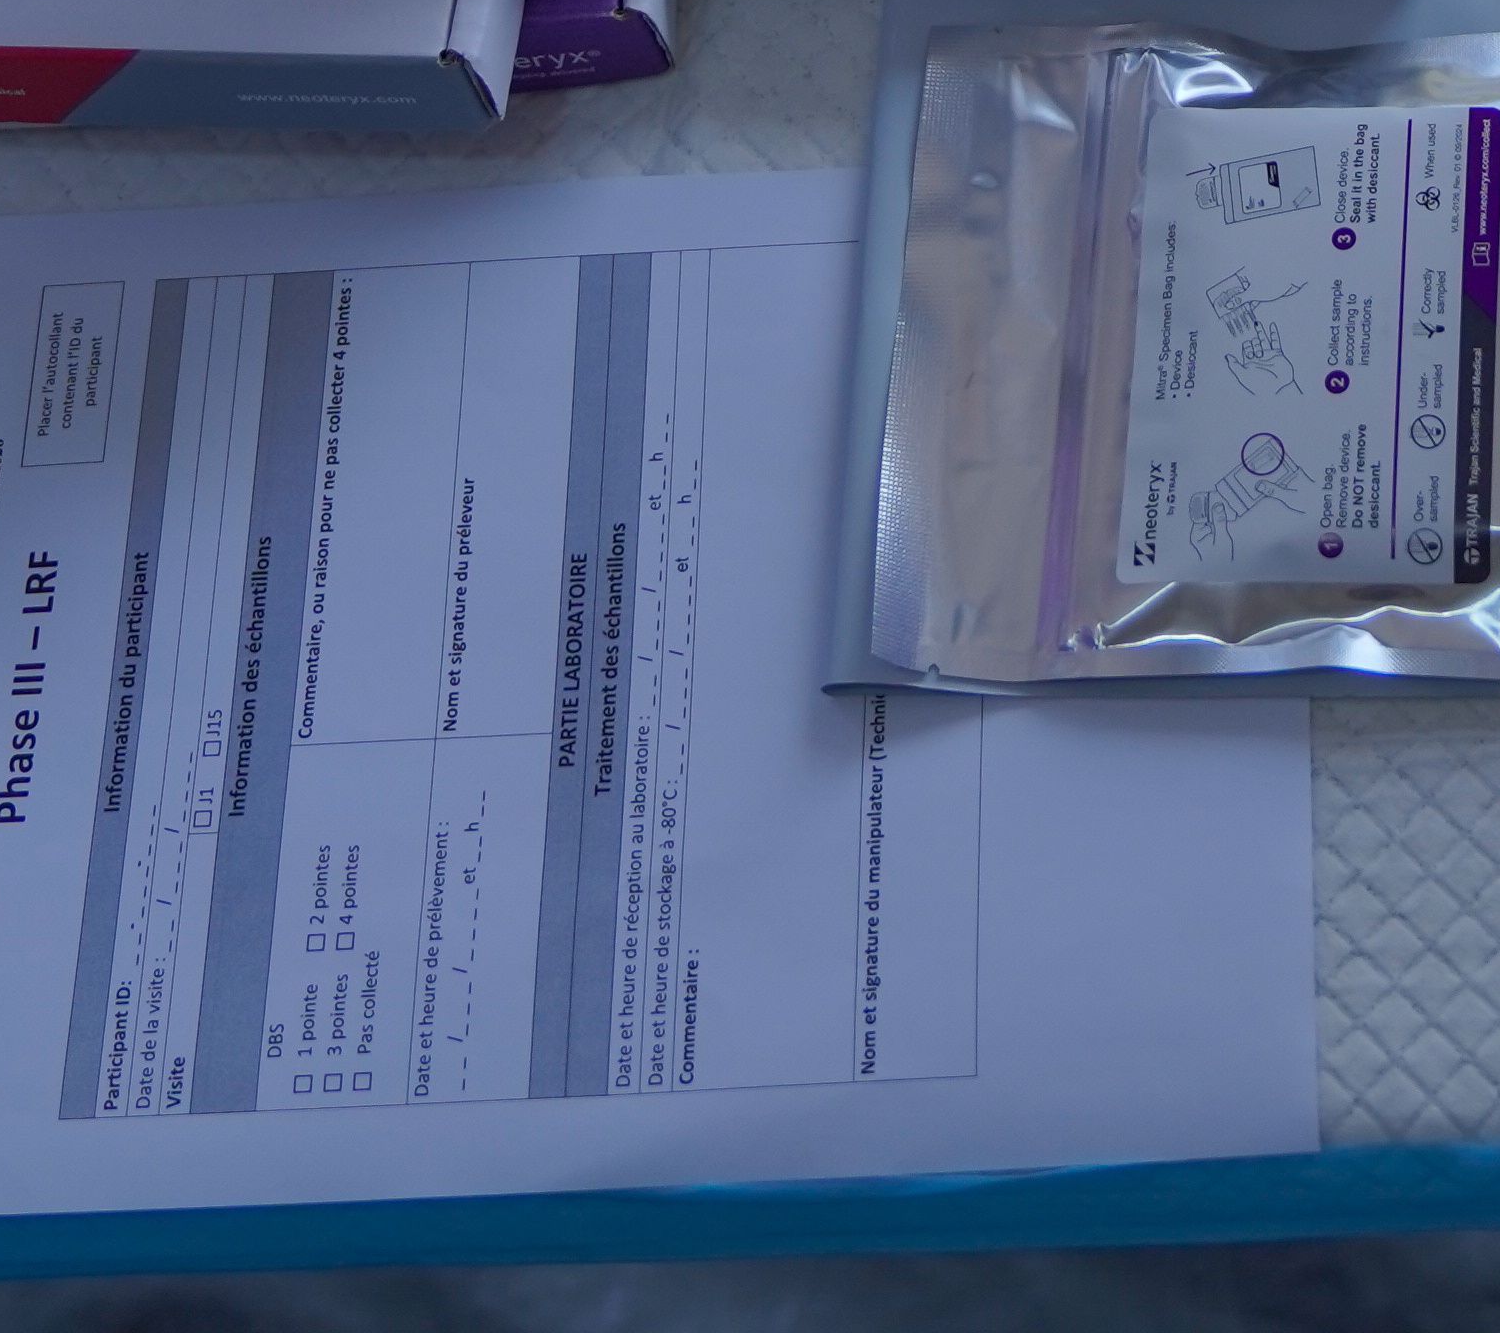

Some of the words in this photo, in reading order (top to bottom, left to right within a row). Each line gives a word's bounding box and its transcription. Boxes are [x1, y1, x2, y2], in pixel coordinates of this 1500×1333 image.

[1353, 122, 1369, 145] bag
[1335, 149, 1350, 188] device.
[1350, 169, 1363, 182] in
[1351, 147, 1365, 168] the
[1366, 131, 1381, 195] desiccant.
[1333, 189, 1348, 224] Close
[1348, 195, 1362, 224] Seal
[1350, 184, 1363, 194] it
[1365, 196, 1378, 224] with
[1330, 278, 1345, 322] sample
[1183, 328, 1199, 390] Desiccant
[1326, 323, 1341, 366] Collect
[1169, 348, 1184, 390] Device
[1355, 422, 1367, 473] remove
[1143, 462, 1165, 540] neoteryx
[1351, 475, 1365, 506] NOT
[1366, 459, 1381, 529] desiccant.
[455, 476, 475, 556] préleveur
[1350, 508, 1364, 529] Do
[1465, 492, 1480, 547] TRAJAN
[20, 549, 60, 615] LRF
[452, 559, 469, 582] du
[600, 520, 628, 641] échantillons
[123, 549, 151, 659] participant
[242, 534, 273, 654] échantillons
[447, 585, 468, 665] signature
[561, 550, 589, 692] LABORATOIRE
[9, 660, 48, 697] III
[117, 662, 137, 688] du
[240, 658, 261, 693] des
[447, 668, 462, 687] et
[599, 644, 620, 679] des
[205, 708, 223, 737] J15
[442, 690, 460, 732] Nom
[557, 696, 580, 767] PARTIE
[101, 692, 135, 813] Information
[226, 696, 258, 818] Information
[592, 682, 619, 798] Traitement
[197, 785, 215, 804] J1
[313, 843, 332, 909] pointes
[308, 913, 326, 925] 2
[114, 979, 133, 1005] ID:
[360, 949, 381, 1019] collecté
[266, 1022, 285, 1058] DBS
[356, 1022, 374, 1054] Pas
[101, 1008, 130, 1112] Participant
[165, 1055, 186, 1109] Visite
